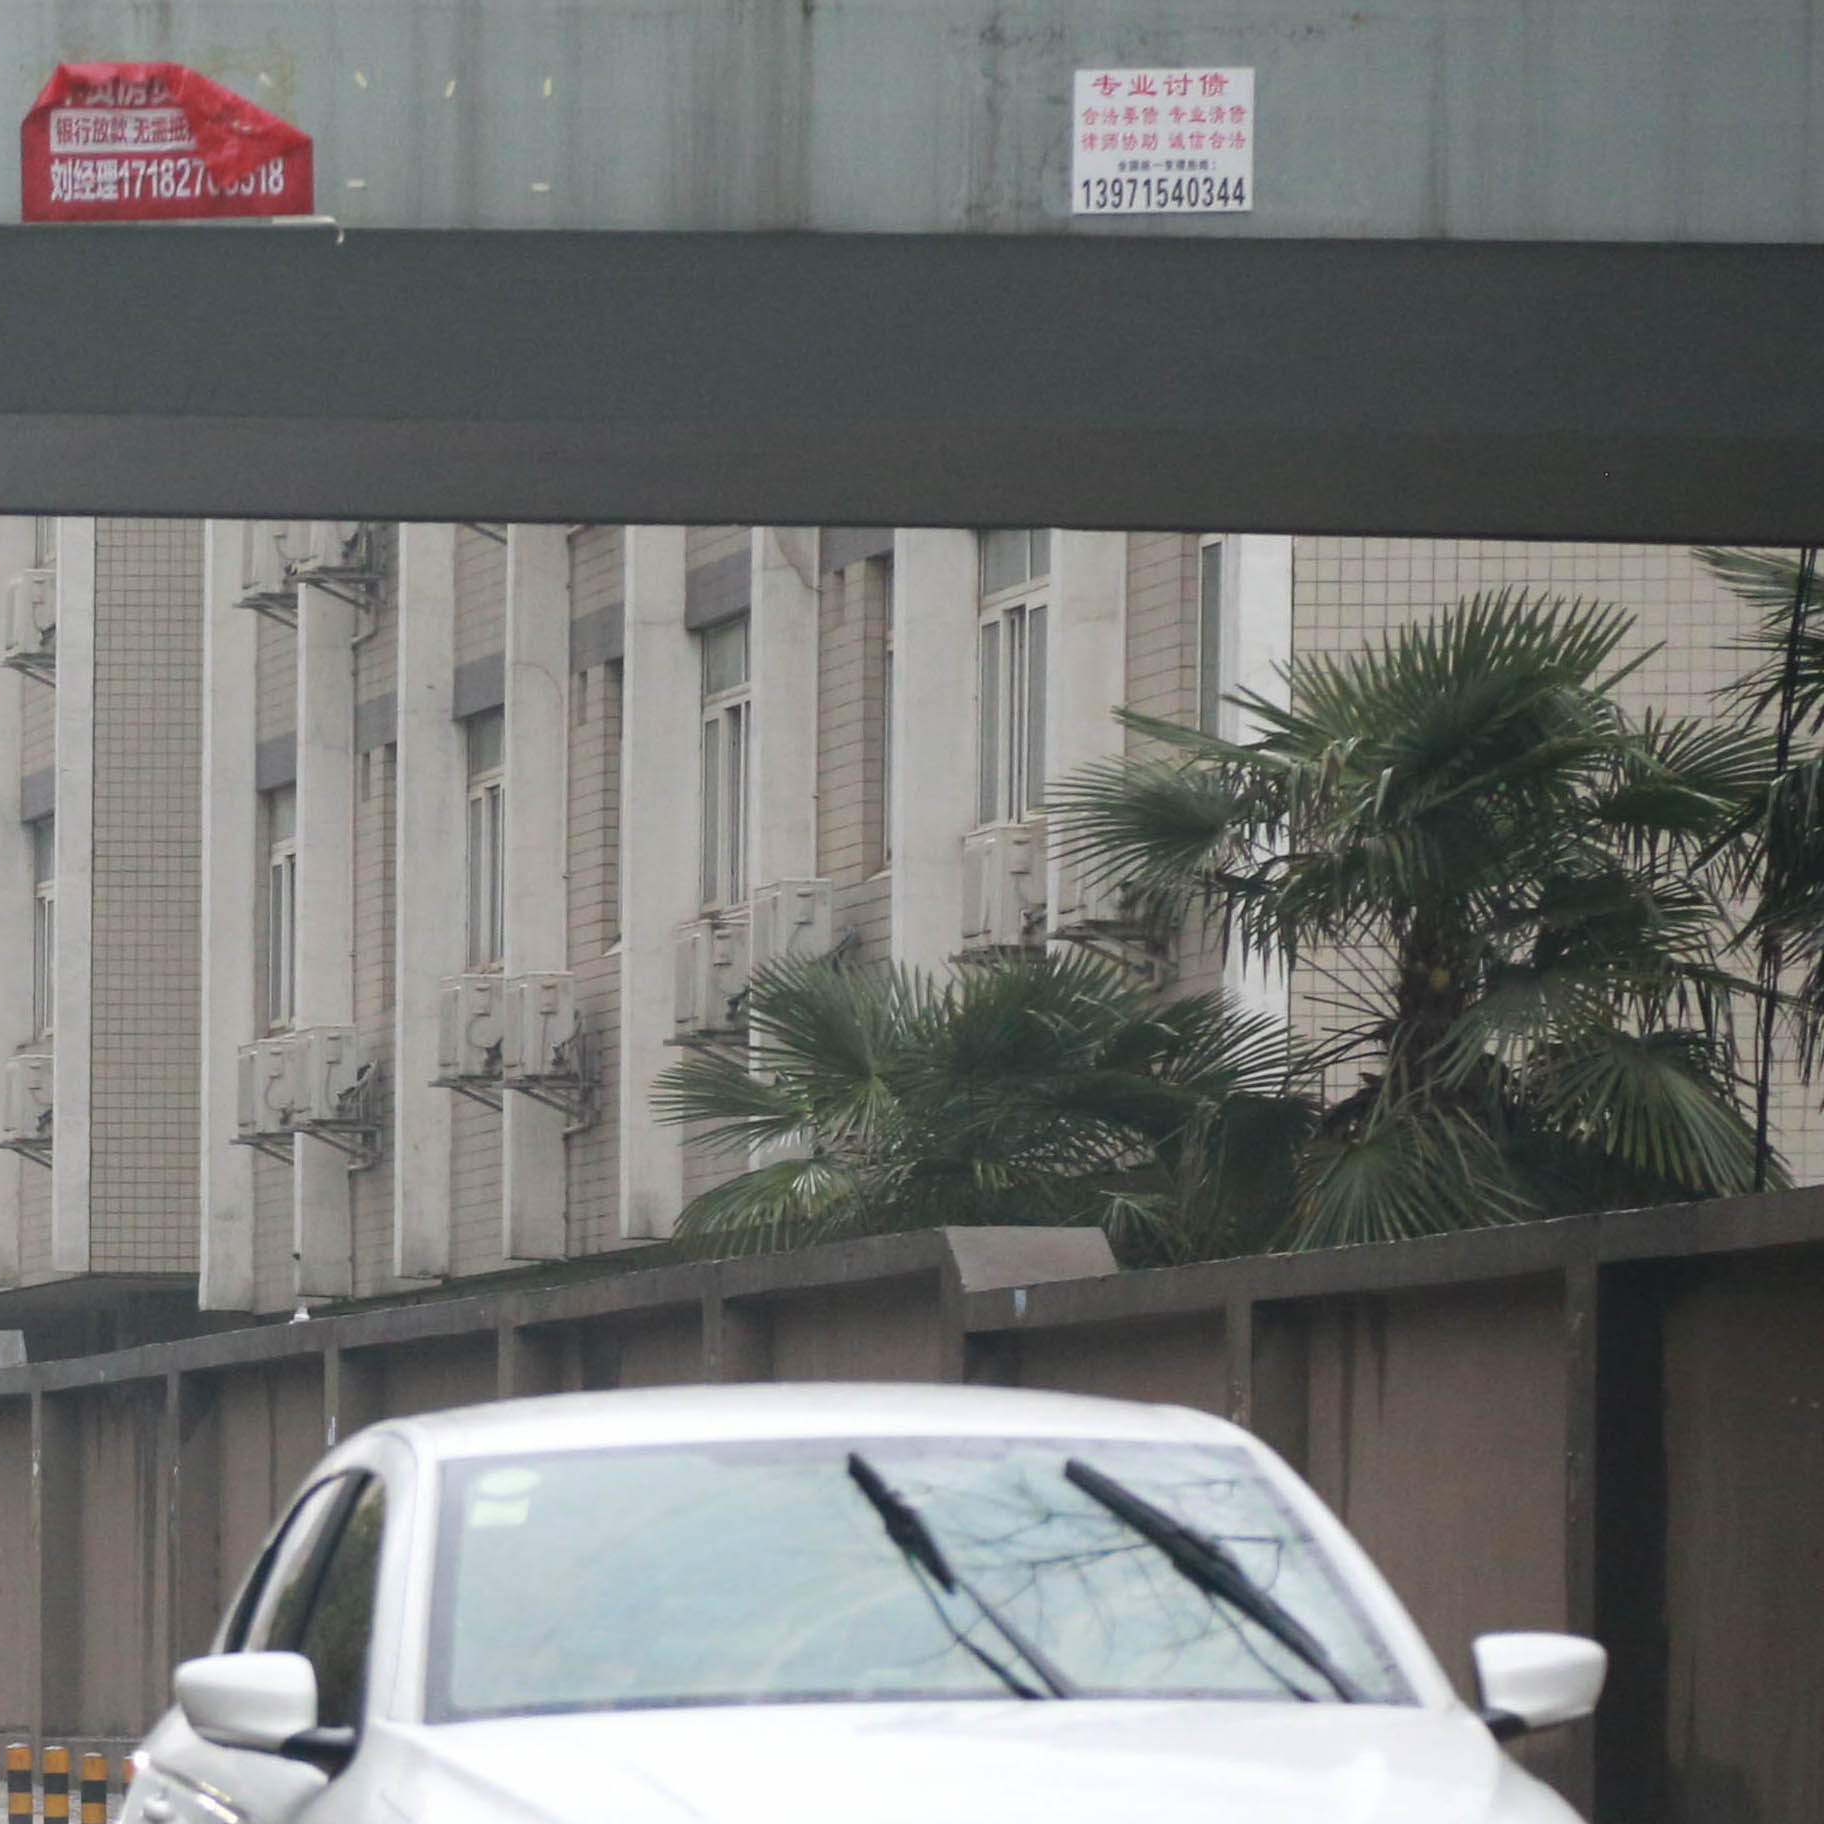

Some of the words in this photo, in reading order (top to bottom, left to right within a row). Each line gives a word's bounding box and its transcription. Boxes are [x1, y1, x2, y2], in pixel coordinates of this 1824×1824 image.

[1092, 73, 1229, 96] 专业讨债
[1082, 176, 1246, 209] 13971540344
